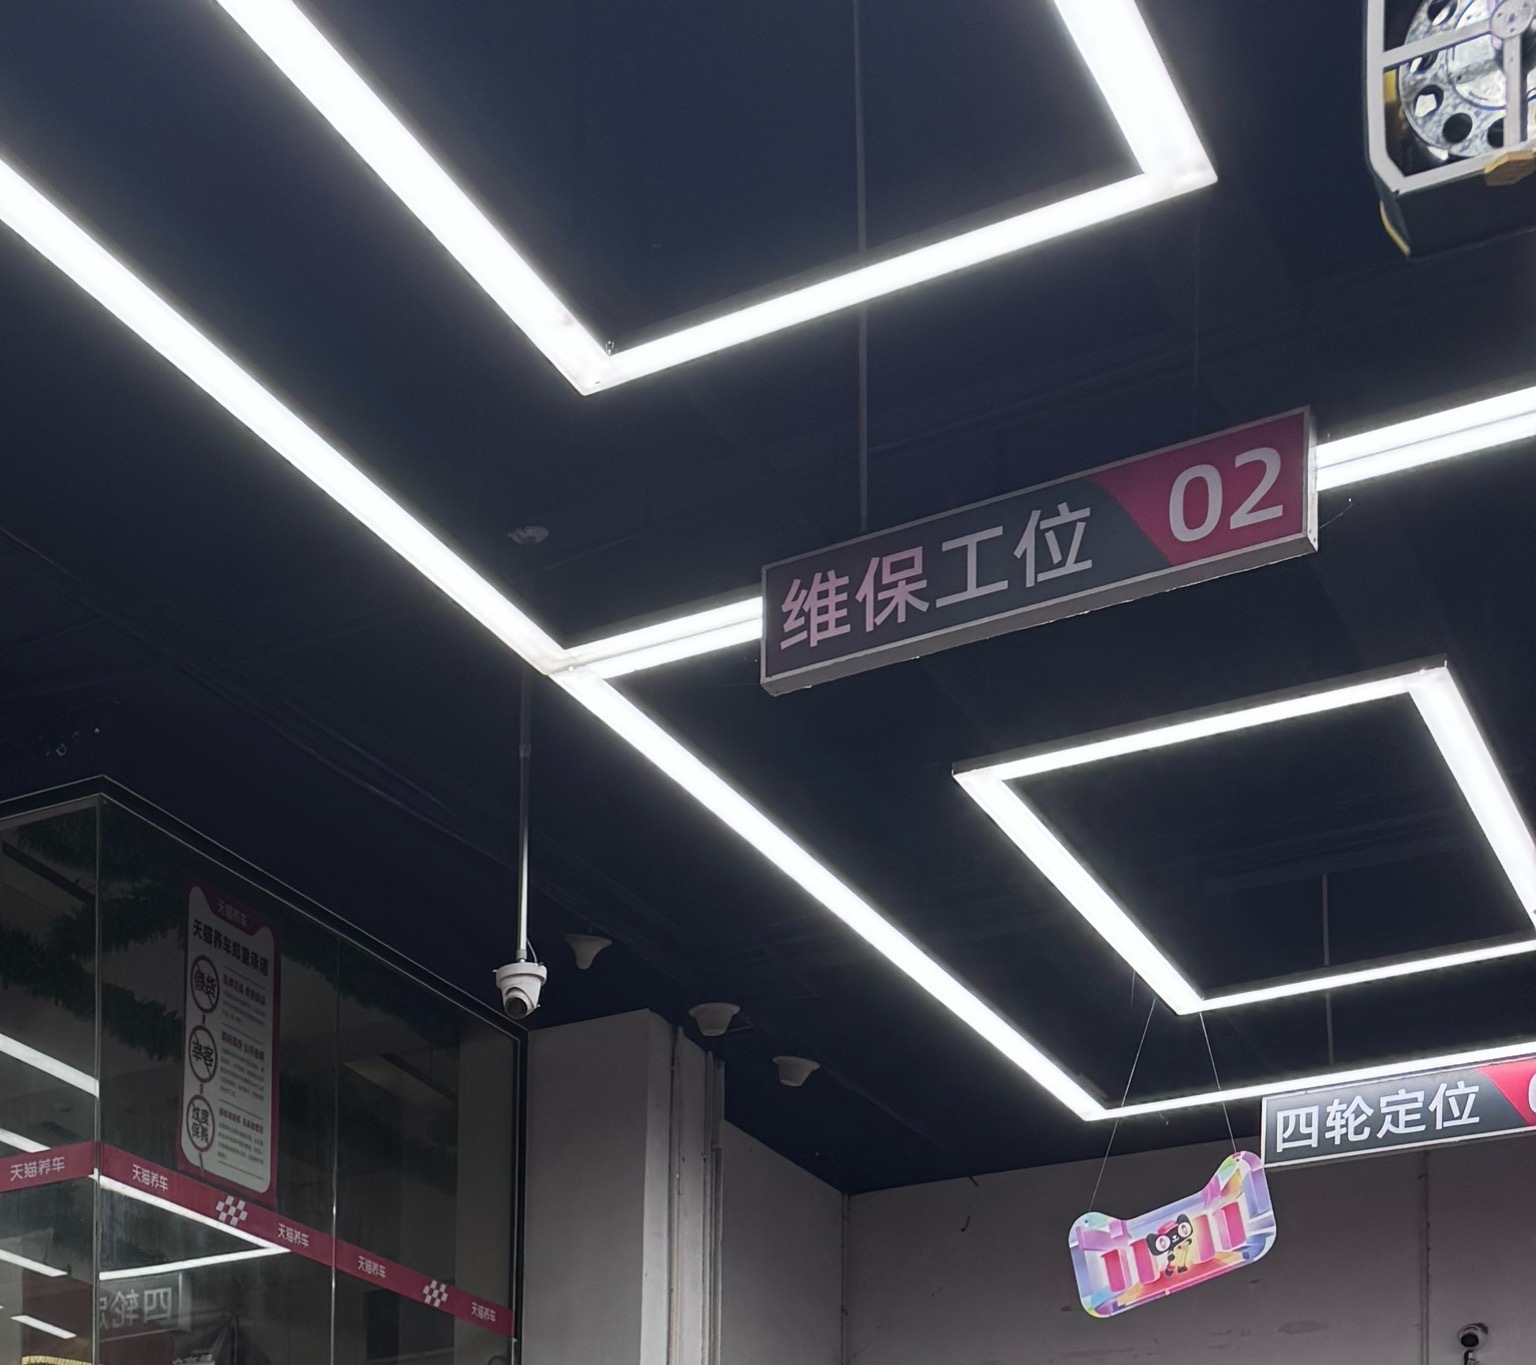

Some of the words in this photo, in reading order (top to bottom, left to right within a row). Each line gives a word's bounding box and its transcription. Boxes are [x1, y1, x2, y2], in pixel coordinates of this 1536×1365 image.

[780, 502, 1093, 650] 维保工位
[1169, 446, 1283, 542] 02
[1276, 1081, 1480, 1153] 四轮定位
[10, 1156, 64, 1181] 天猫养车
[132, 1164, 168, 1191] 天猫养车
[278, 1223, 309, 1248] 天猫养车
[358, 1255, 386, 1279] 天猫养车
[471, 1302, 496, 1322] 天猫养车
